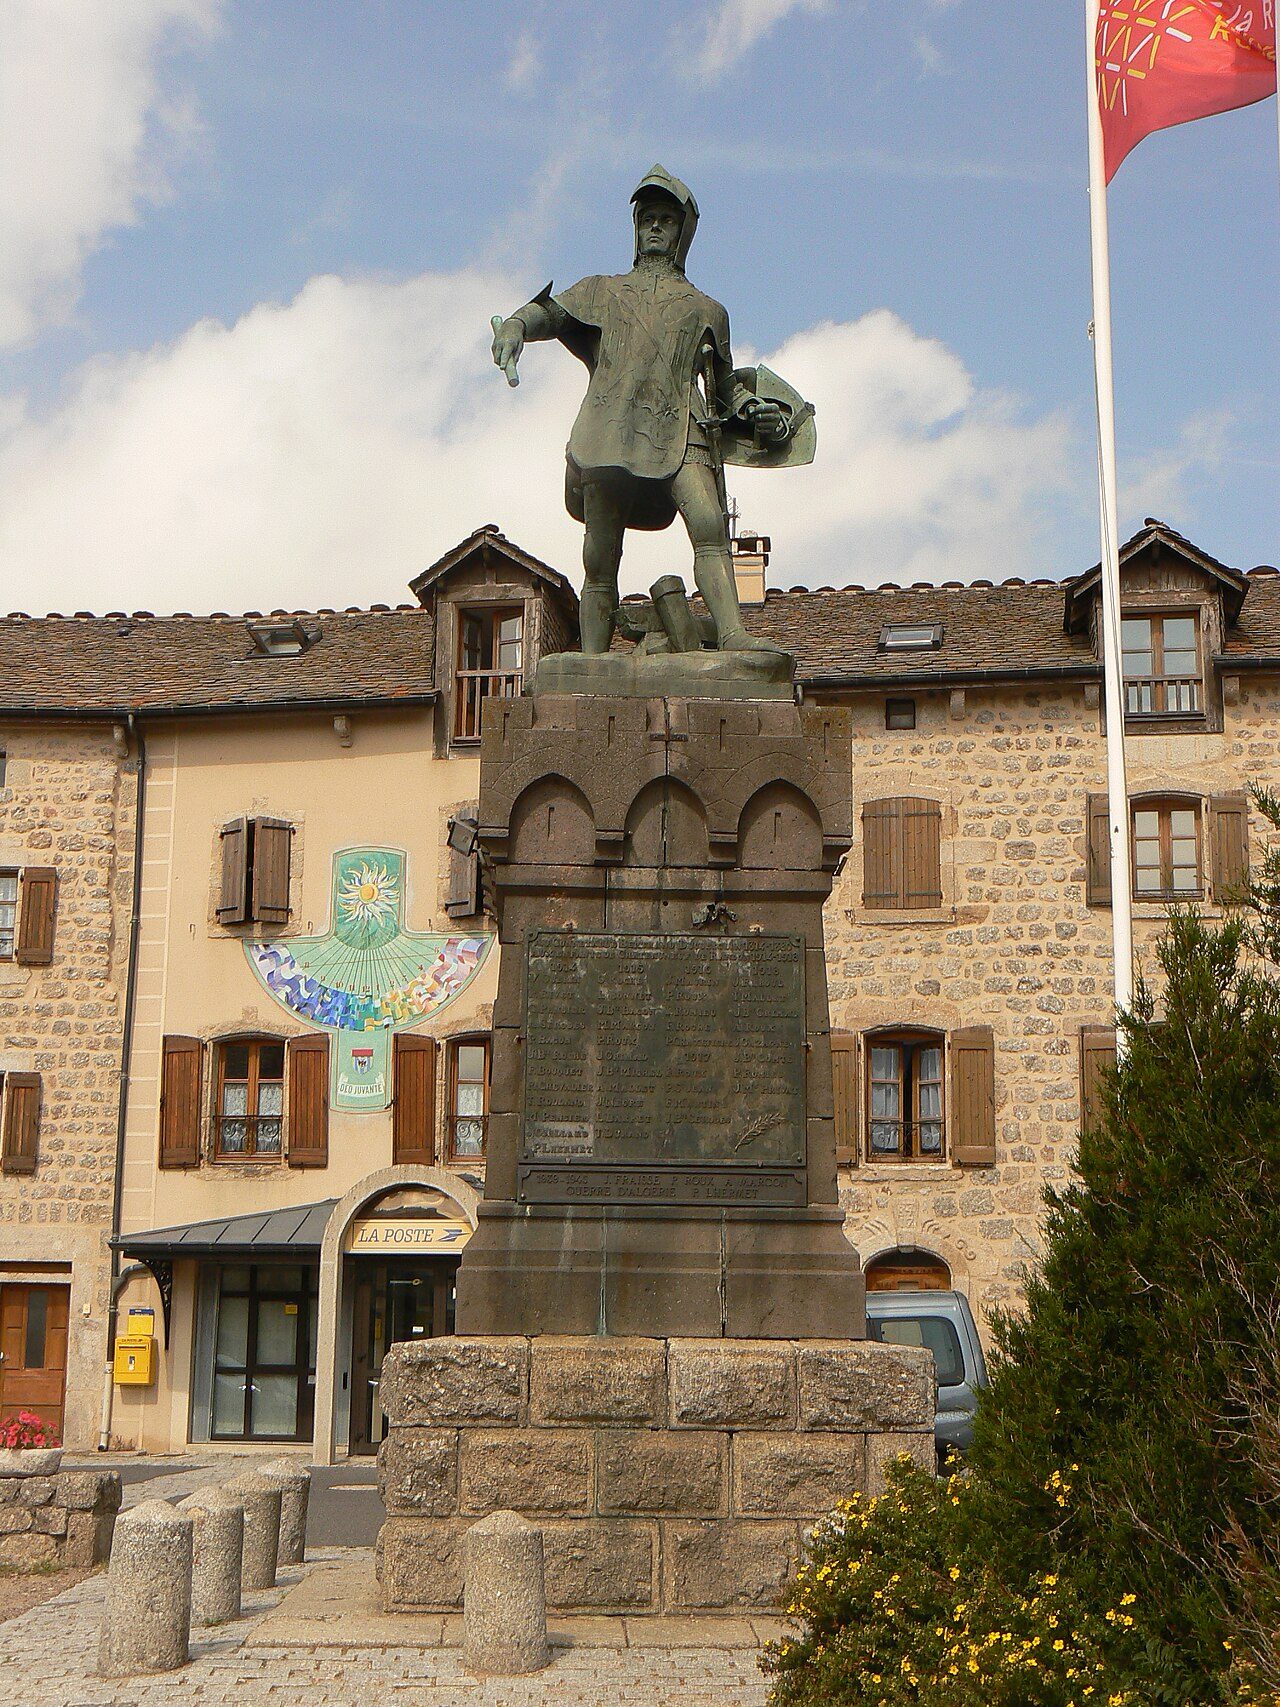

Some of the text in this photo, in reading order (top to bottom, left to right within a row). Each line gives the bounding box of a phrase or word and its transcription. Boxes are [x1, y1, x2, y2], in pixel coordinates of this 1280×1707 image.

[340, 1083, 383, 1095] DEO JUVANTE
[615, 1175, 661, 1186] FRAISSE
[684, 1177, 715, 1187] ROUX
[566, 1186, 611, 1197] GUERRE
[358, 1228, 435, 1243] LA POSTE
